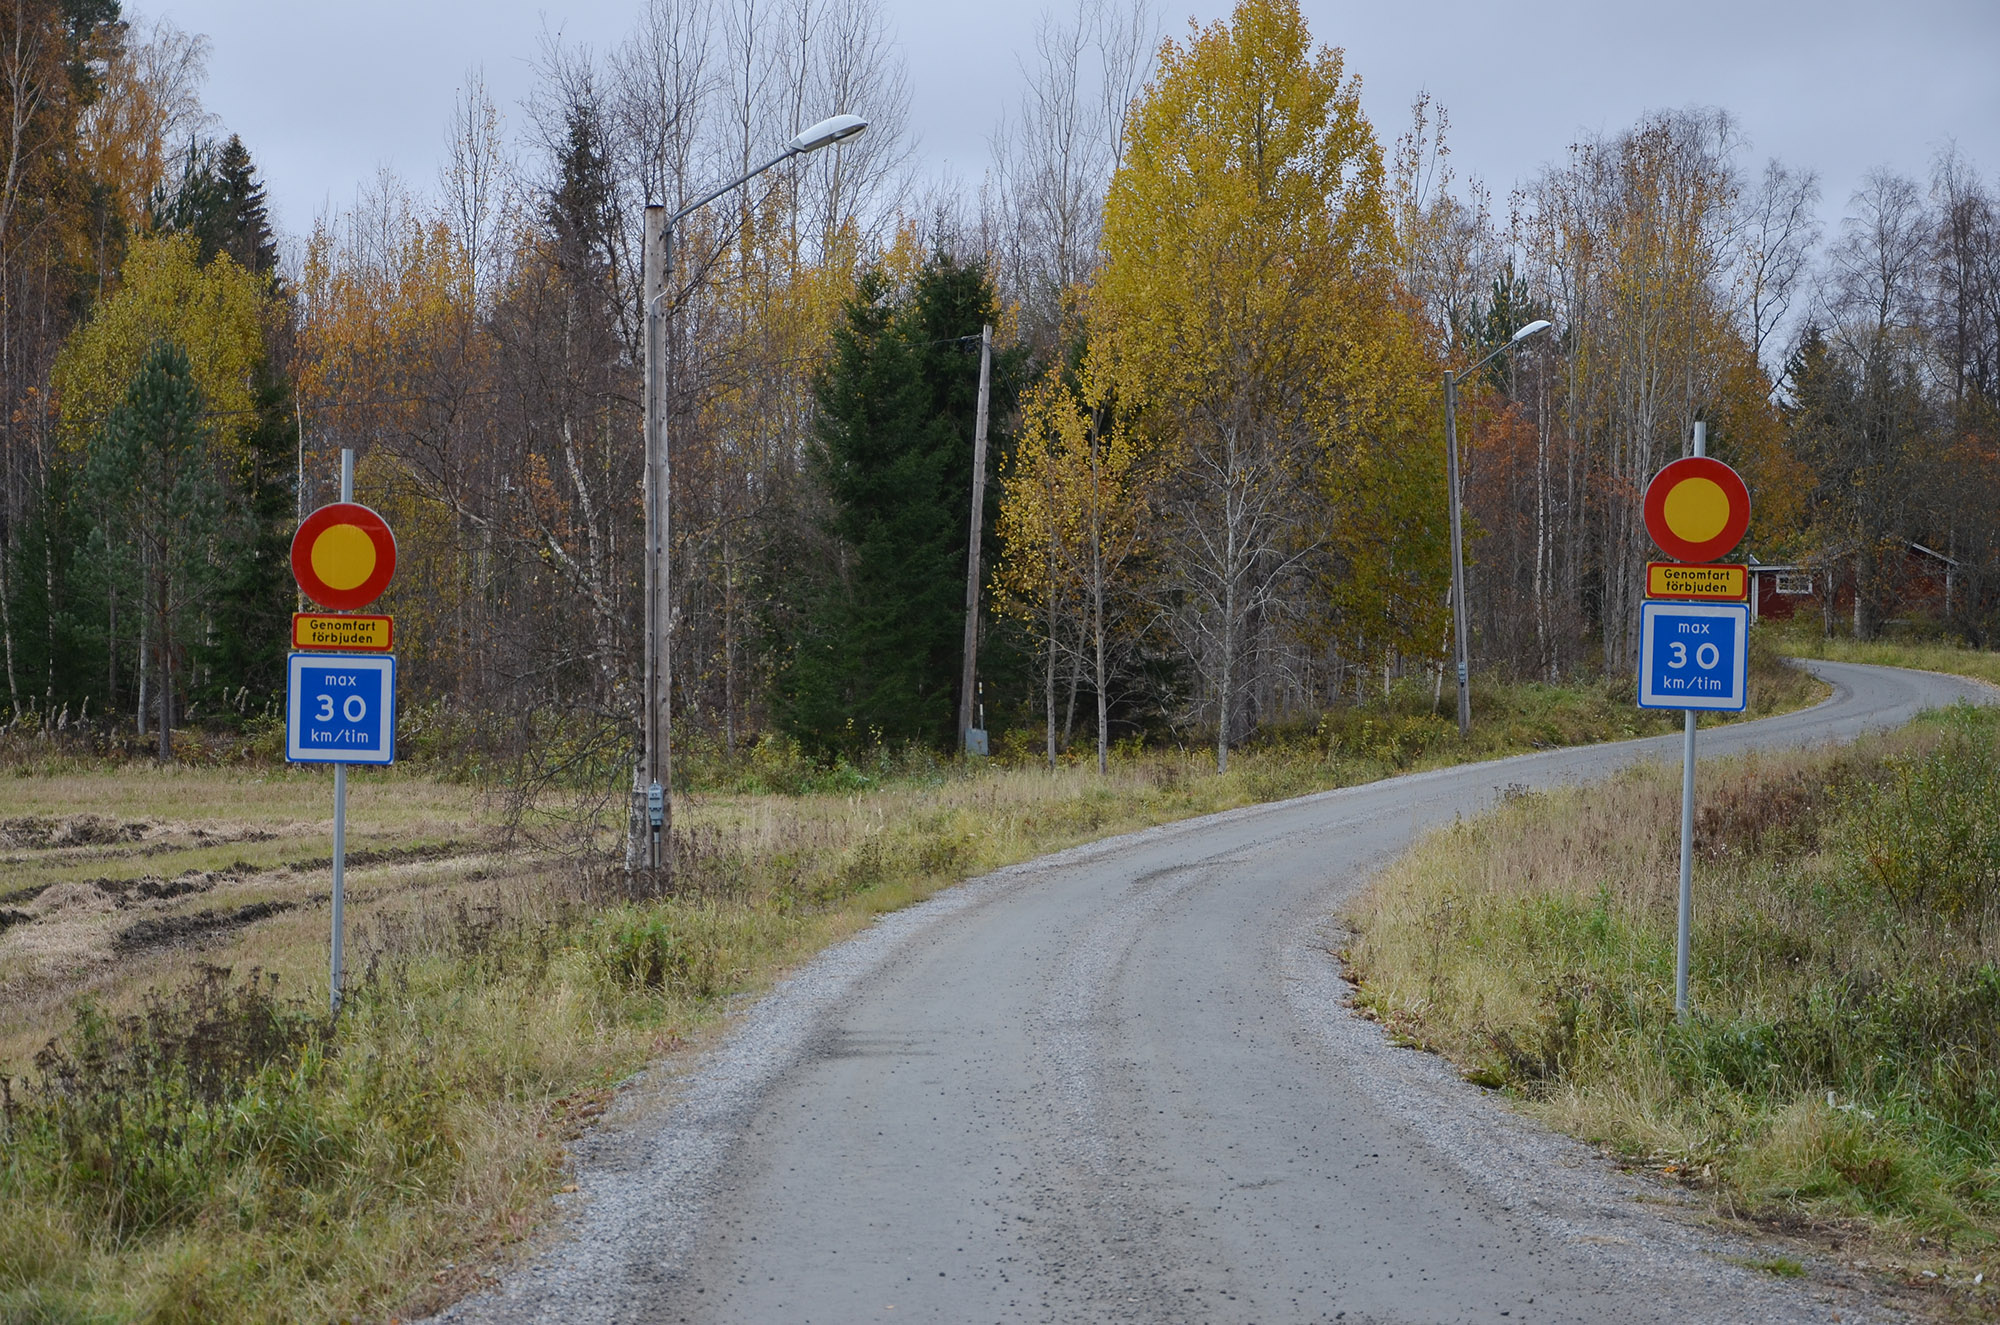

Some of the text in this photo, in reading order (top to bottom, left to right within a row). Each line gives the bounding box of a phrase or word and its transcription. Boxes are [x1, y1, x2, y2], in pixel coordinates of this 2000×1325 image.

[1664, 569, 1730, 580] Genomfart
[1666, 581, 1727, 594] förbjuden
[310, 620, 376, 631] Genomfart
[1678, 623, 1710, 634] max
[312, 632, 373, 645] förbjuden
[1667, 642, 1720, 670] 30
[325, 675, 357, 686] max
[1663, 675, 1721, 690] km/tim
[315, 694, 367, 723] 30
[311, 728, 369, 743] km/tim
